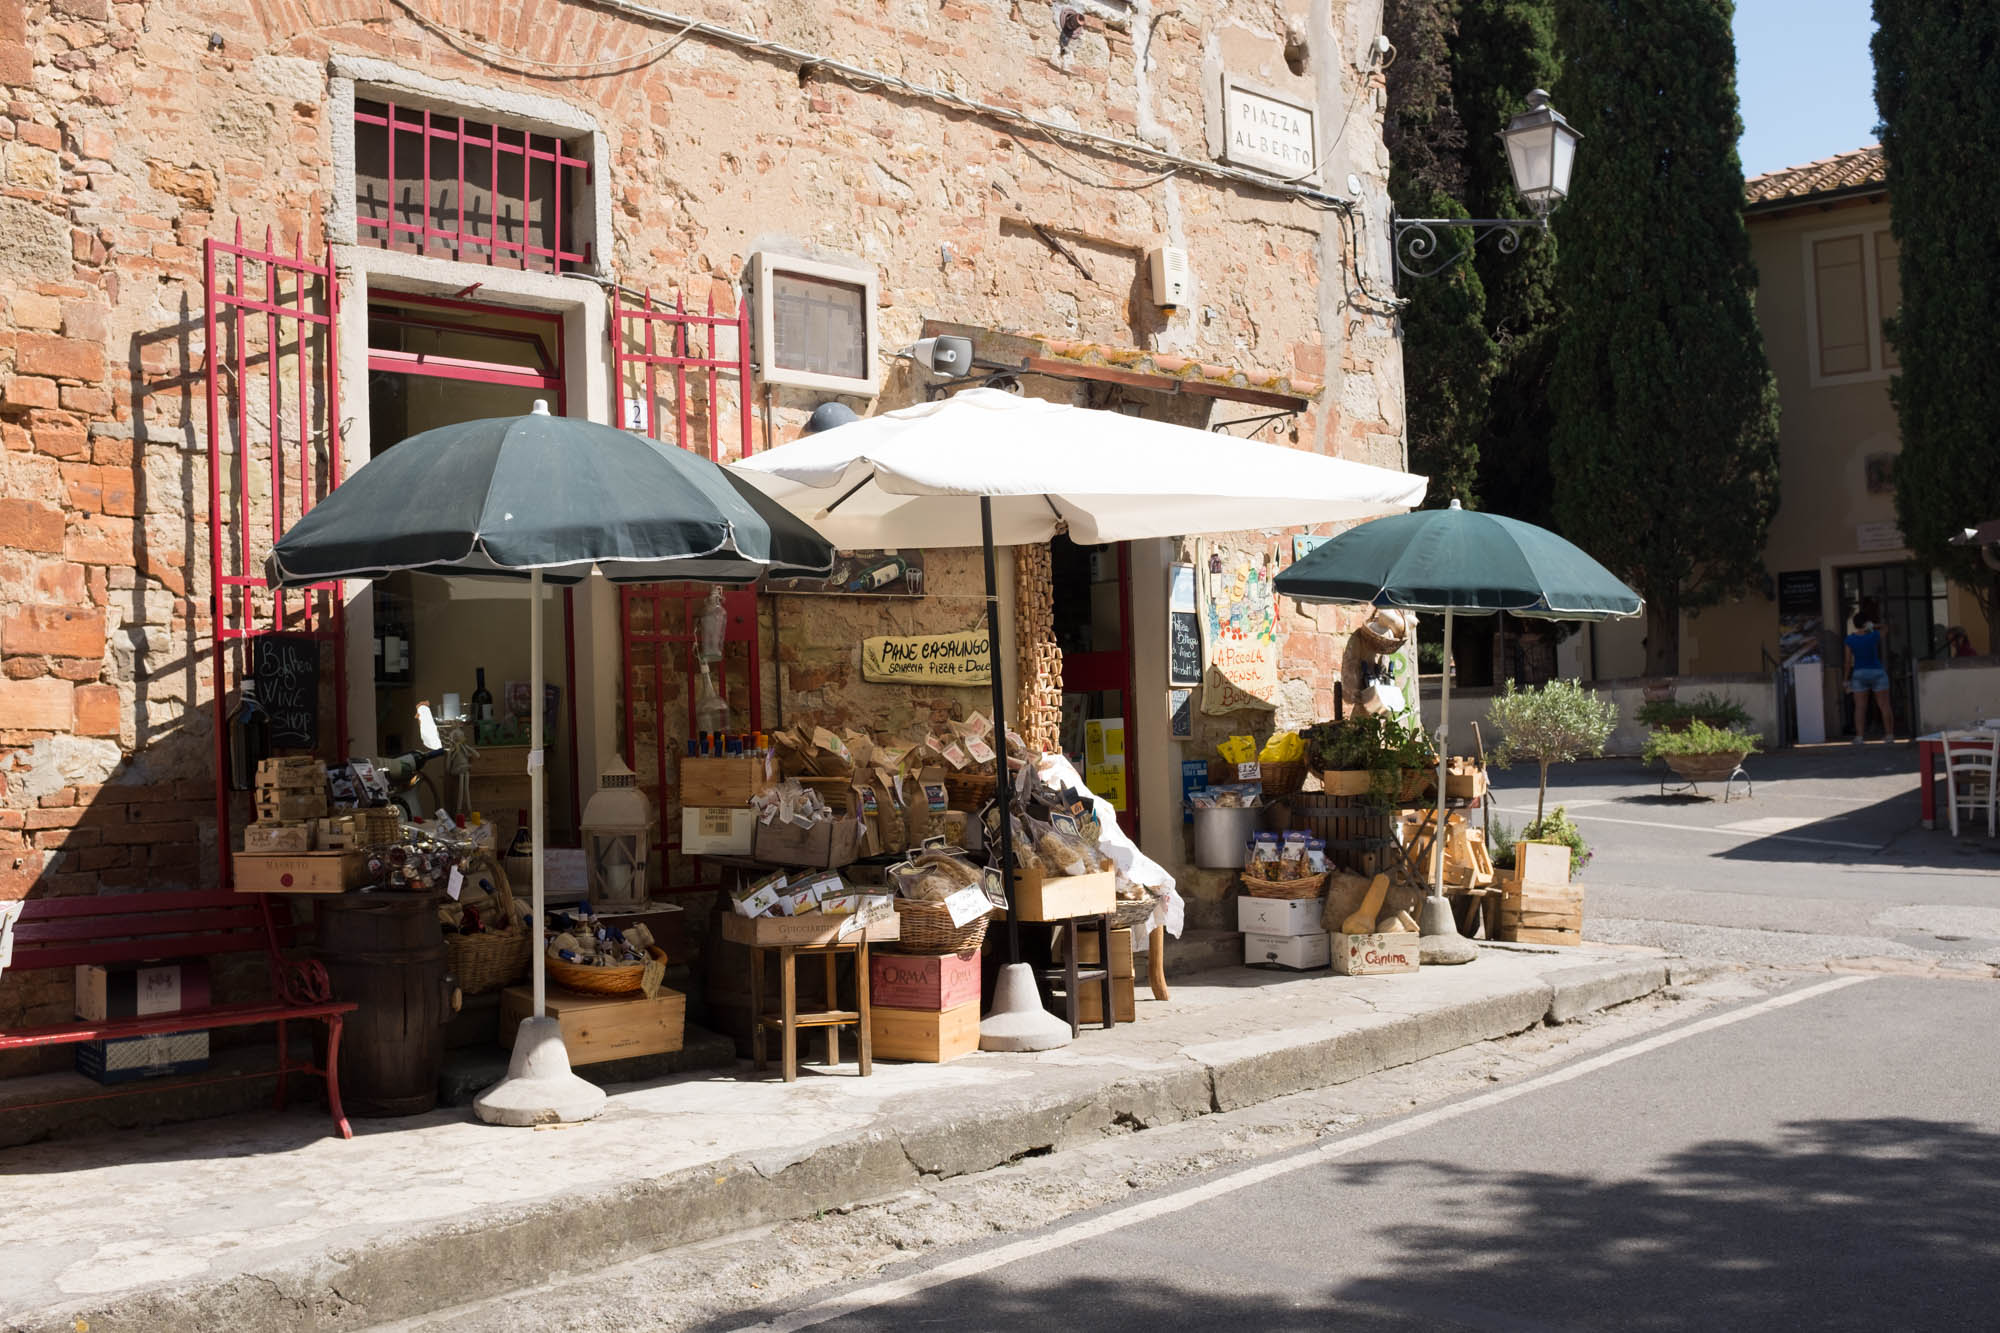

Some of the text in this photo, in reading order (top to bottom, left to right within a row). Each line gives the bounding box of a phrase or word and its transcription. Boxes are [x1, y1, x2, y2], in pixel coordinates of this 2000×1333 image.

[1242, 103, 1300, 136] PIAZZA
[1235, 130, 1311, 165] ALBERTO
[633, 405, 641, 424] 2
[882, 639, 989, 663] PANE CASALINGO
[1211, 645, 1224, 667] LA
[929, 661, 956, 674] PIZZA
[259, 678, 305, 708] WINE
[882, 966, 928, 985] ORMA
